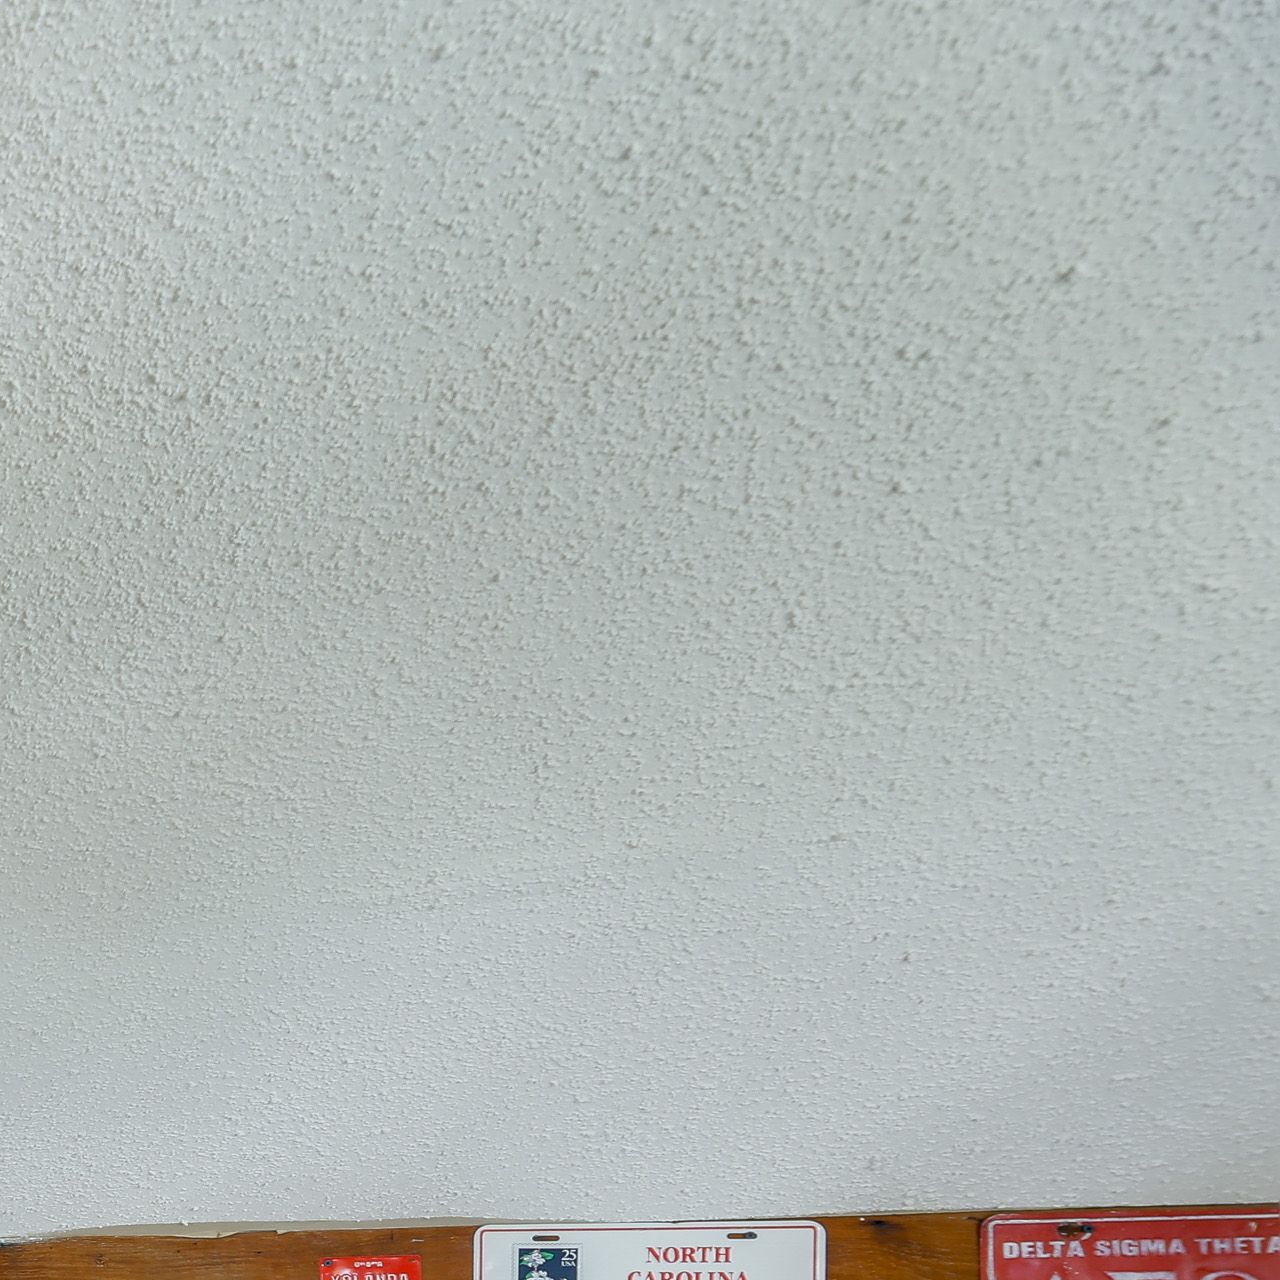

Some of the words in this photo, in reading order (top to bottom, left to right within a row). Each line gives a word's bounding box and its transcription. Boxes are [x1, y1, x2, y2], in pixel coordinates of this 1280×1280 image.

[561, 1249, 577, 1261] 25
[646, 1246, 733, 1264] NORTH
[1002, 1240, 1085, 1259] DELTA
[1093, 1238, 1186, 1257] SIGMA
[1194, 1235, 1280, 1254] THETA
